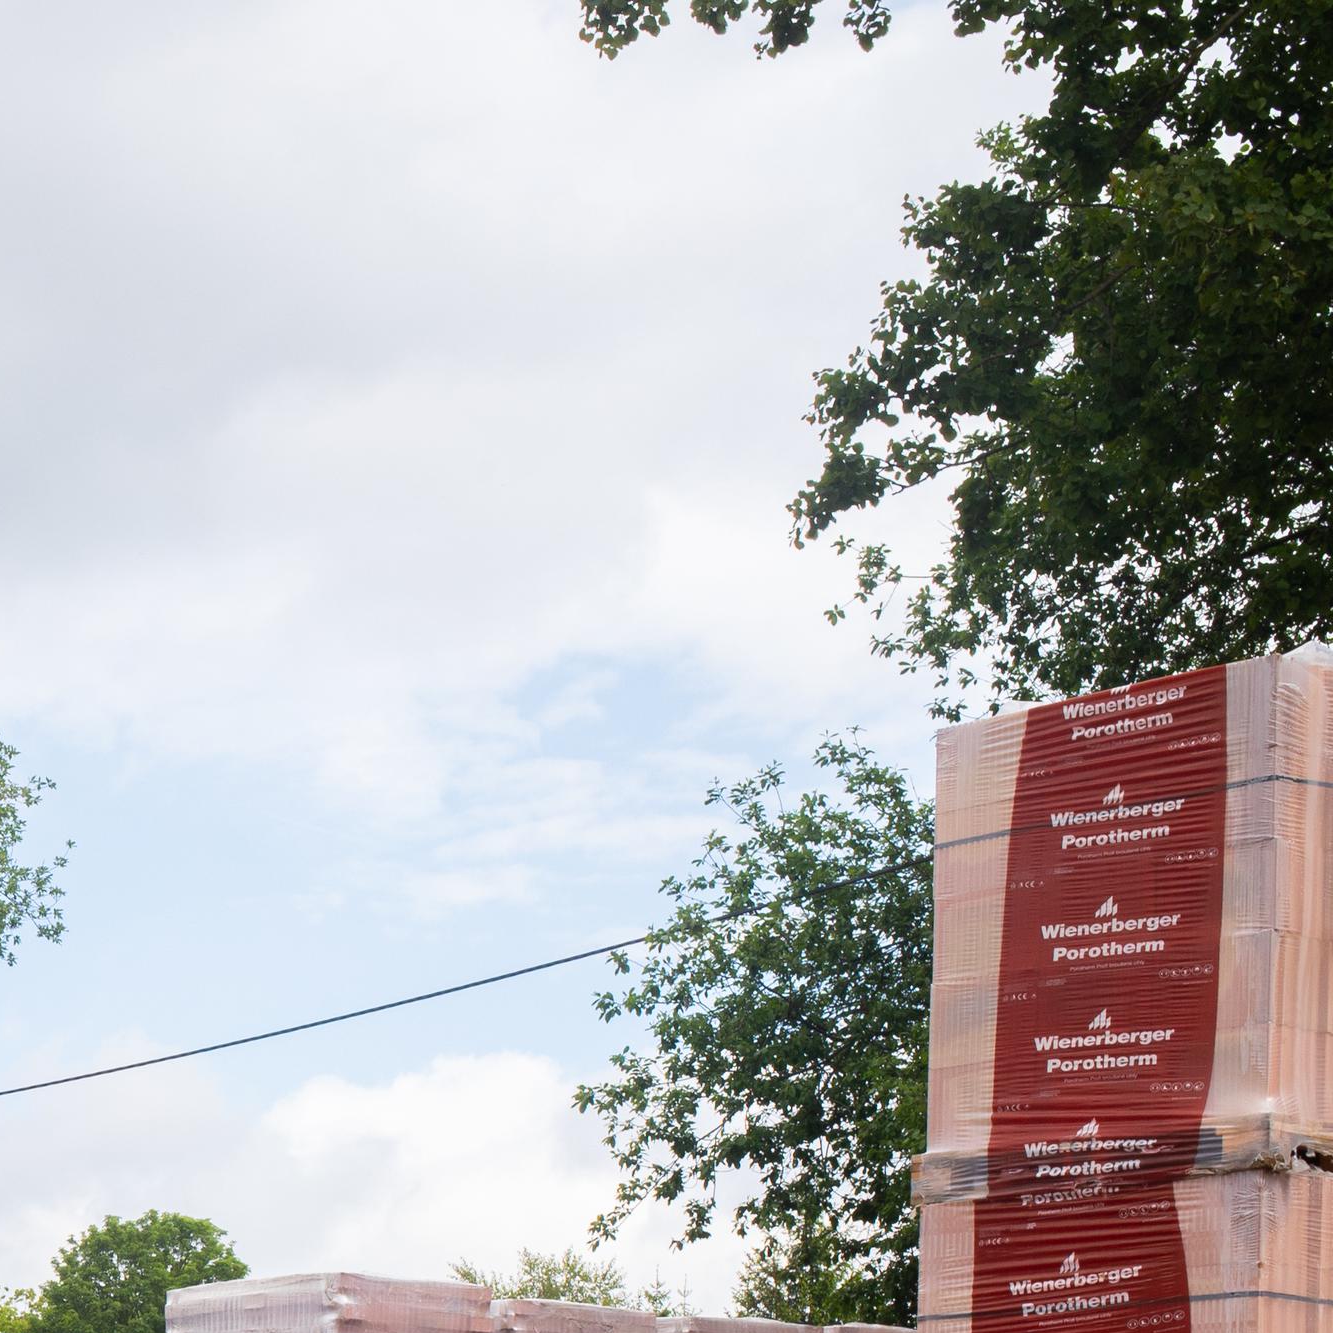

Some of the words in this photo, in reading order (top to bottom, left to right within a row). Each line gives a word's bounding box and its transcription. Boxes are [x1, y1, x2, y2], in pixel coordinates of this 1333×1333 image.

[1062, 685, 1187, 720] Wienerberger
[1071, 712, 1173, 741] Porotherm
[1050, 798, 1186, 828] Wienerberger
[1061, 824, 1170, 850] Porotherm
[1041, 913, 1182, 940] Wienerberger
[1052, 939, 1166, 962] Porotherm
[1033, 1028, 1176, 1052] Wienerberger
[1046, 1053, 1158, 1074] Porotherm
[1024, 1137, 1158, 1158] Wienerberger
[1035, 1159, 1141, 1178] Porotherm
[1008, 1264, 1143, 1296] Wienerberger
[1021, 1291, 1130, 1317] Porotherm
